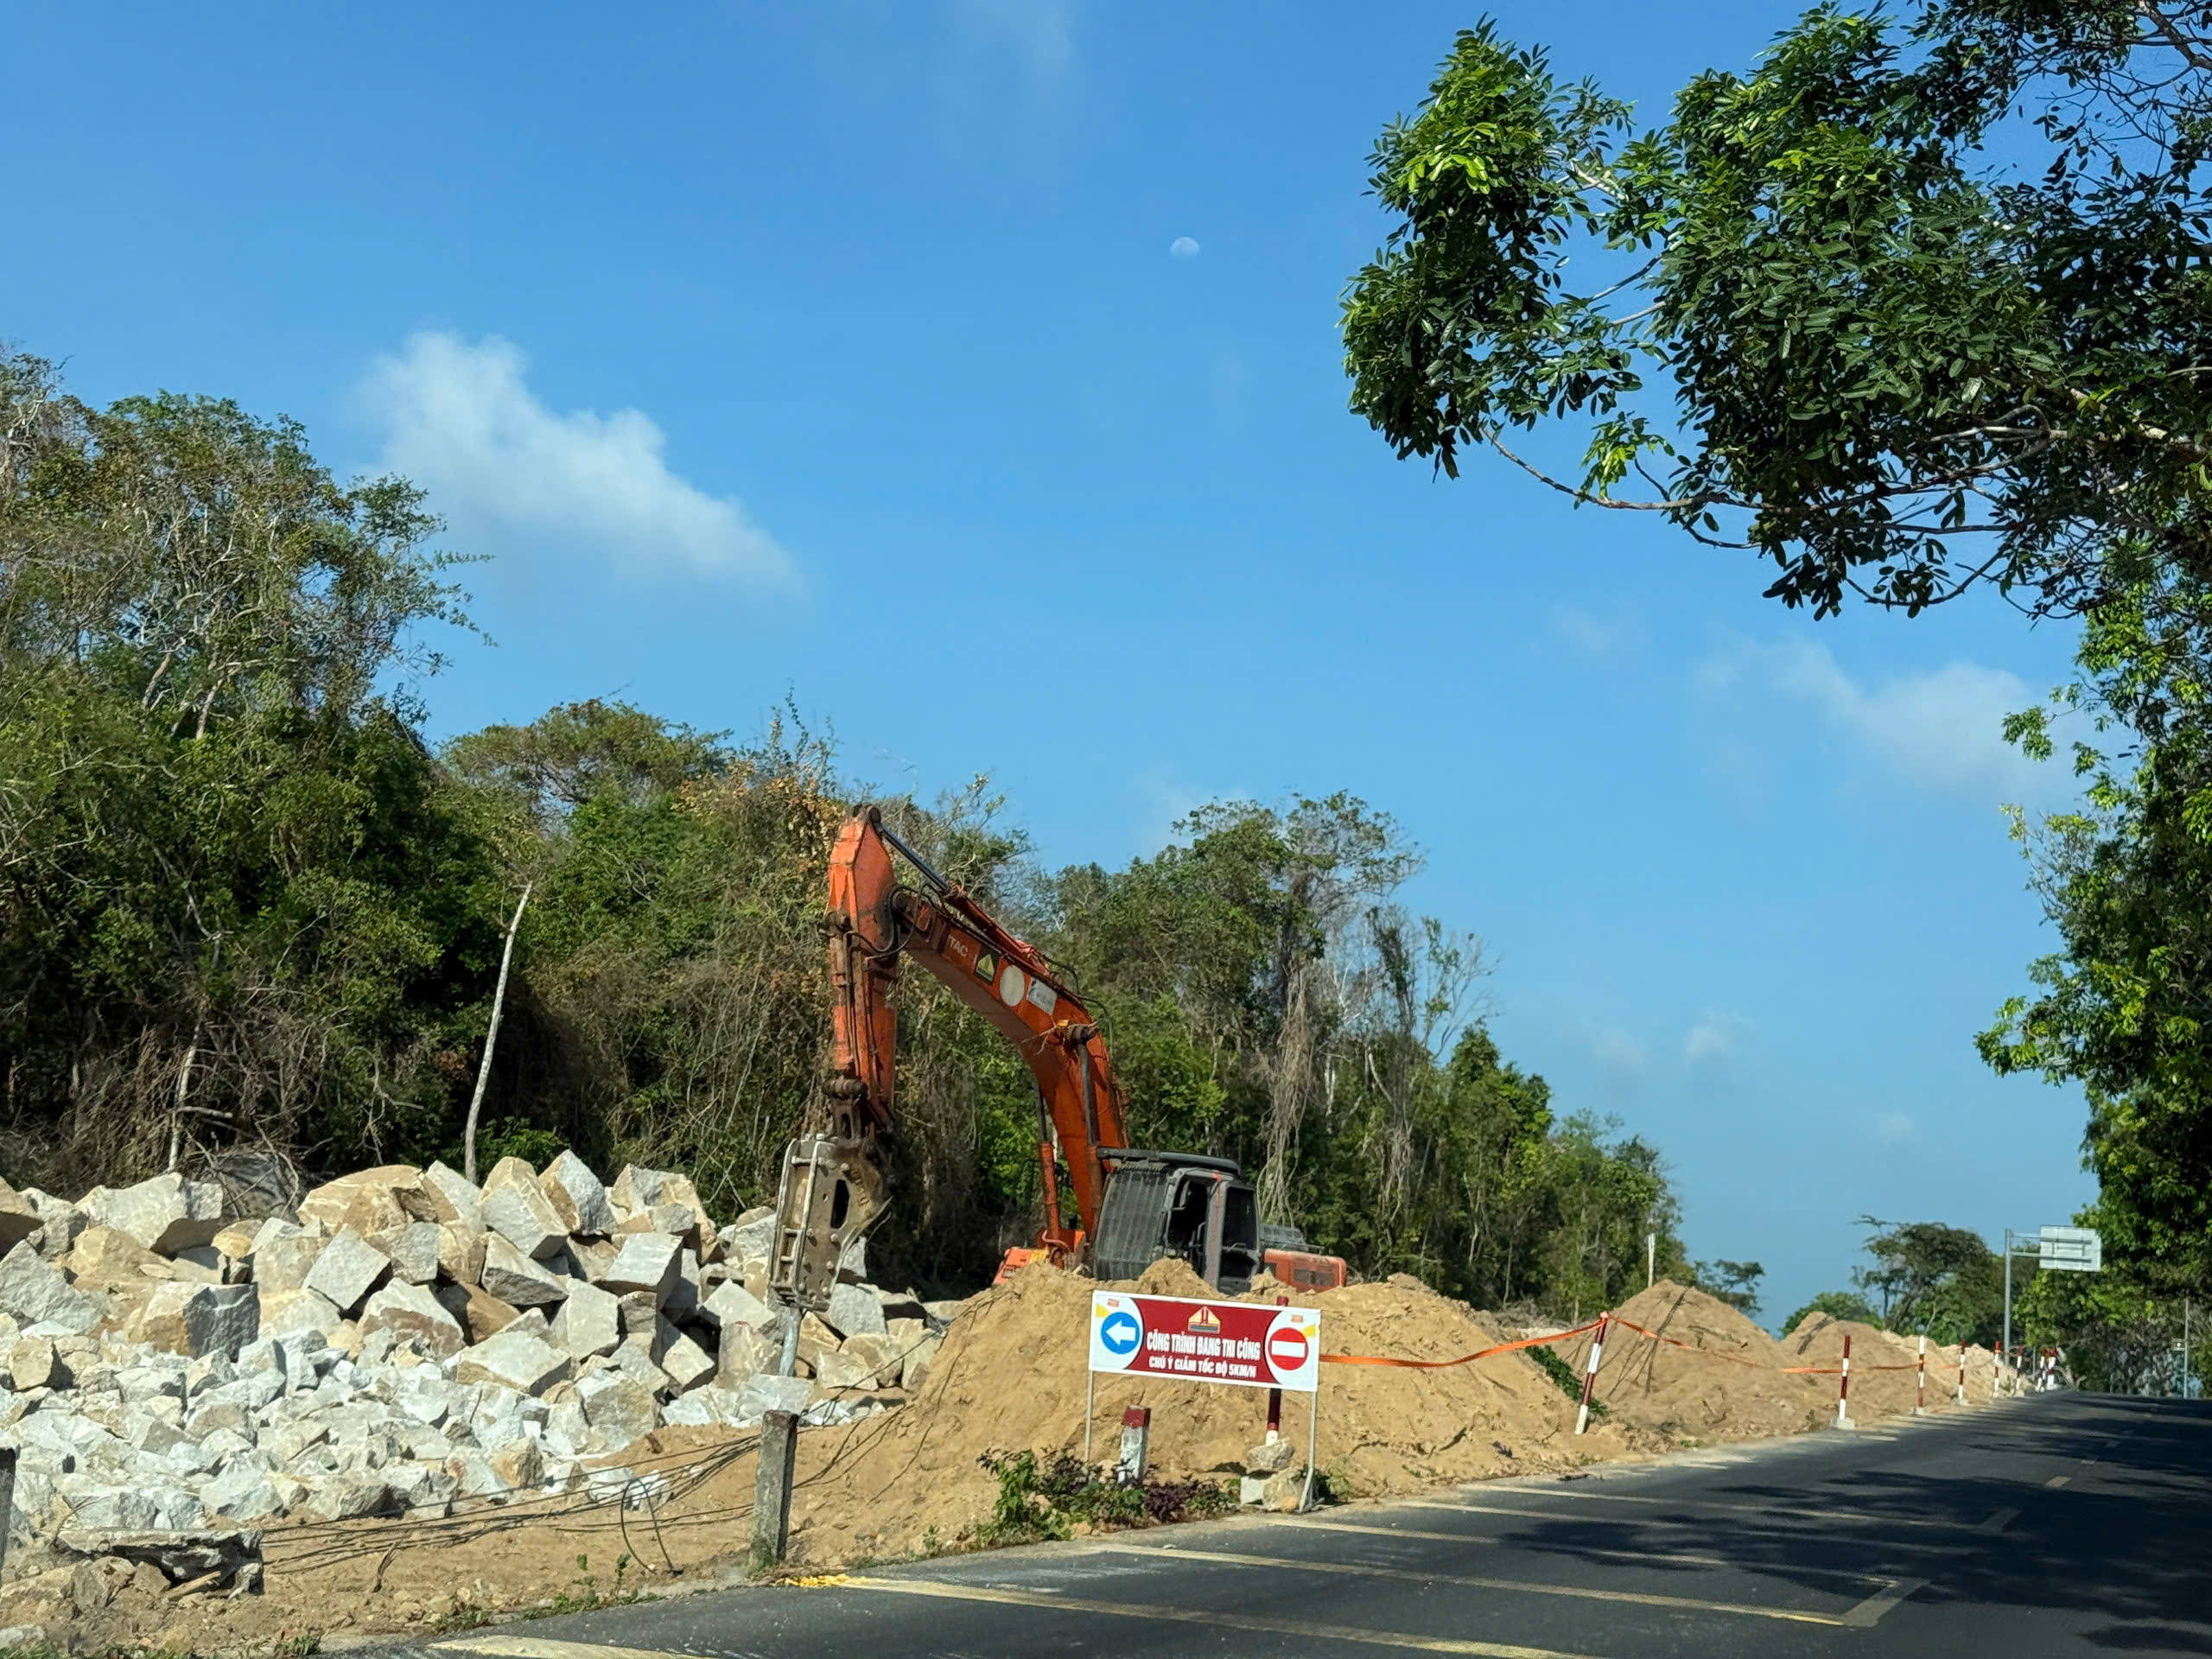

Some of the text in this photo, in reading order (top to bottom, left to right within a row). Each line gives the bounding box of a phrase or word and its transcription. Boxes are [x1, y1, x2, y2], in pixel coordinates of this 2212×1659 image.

[1147, 1329, 1170, 1351] CÔNG
[1171, 1332, 1197, 1354] TRÌNH
[1222, 1338, 1236, 1357] THI
[1236, 1337, 1262, 1361] CÔNG
[1148, 1355, 1257, 1378] CHÚ Ý GIẢM TỐC ĐỘ 5KM/H
